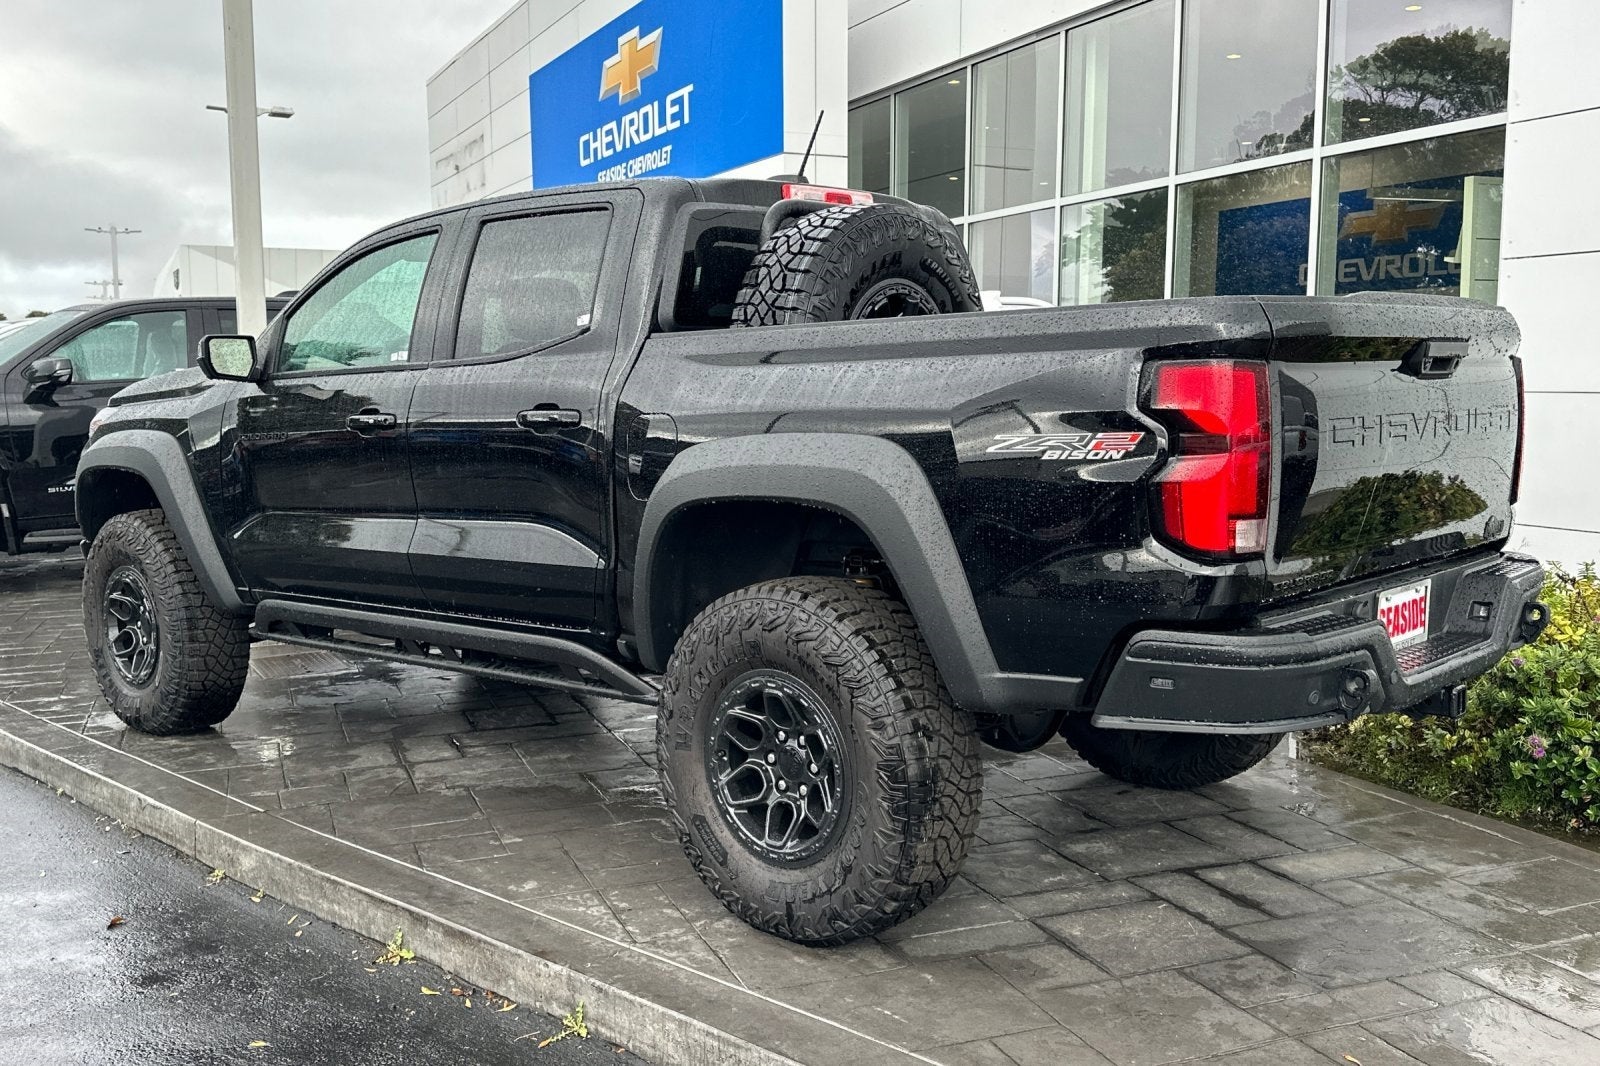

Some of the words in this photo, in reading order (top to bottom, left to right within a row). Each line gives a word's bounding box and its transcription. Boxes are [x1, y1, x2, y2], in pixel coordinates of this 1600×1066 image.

[579, 83, 694, 167] CHEVROLET
[626, 144, 673, 178] CHEVROLET
[986, 431, 1144, 453] ZR2
[1040, 449, 1126, 460] BISON
